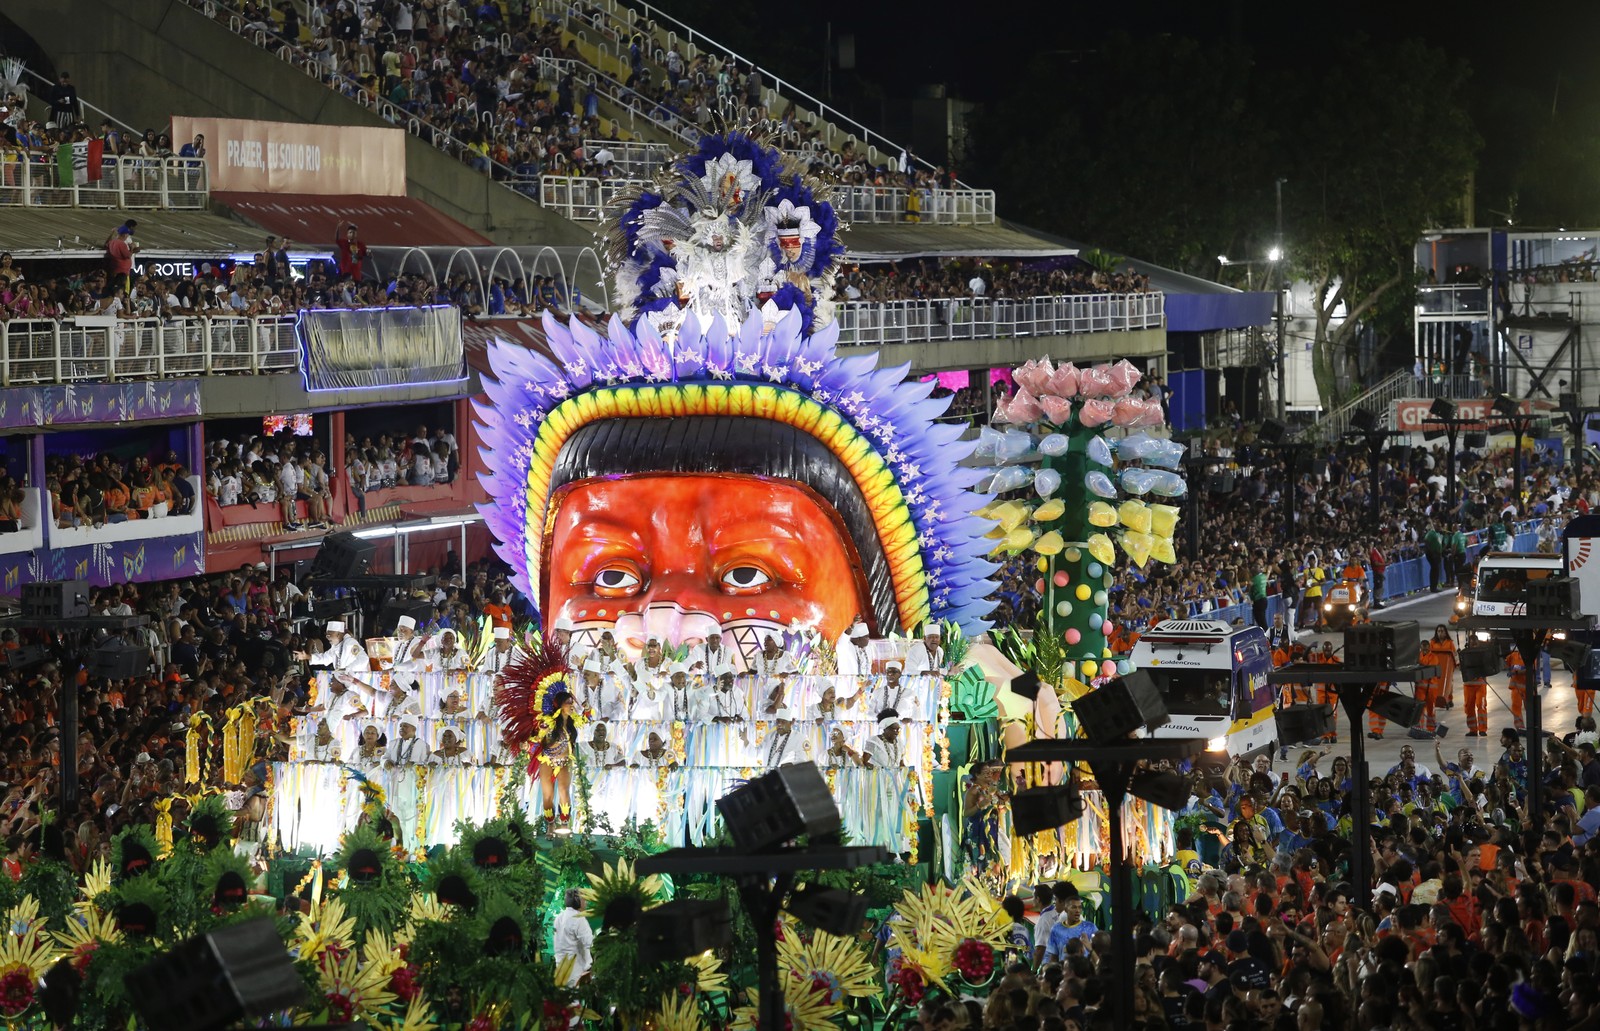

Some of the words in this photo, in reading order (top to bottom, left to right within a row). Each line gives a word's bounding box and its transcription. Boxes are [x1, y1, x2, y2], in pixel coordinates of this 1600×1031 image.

[227, 140, 265, 173] PRAZER,
[267, 142, 278, 169] EU
[280, 143, 297, 170] SOU
[298, 144, 304, 170] O
[306, 145, 320, 171] RIO
[133, 262, 192, 276] MROTE
[1402, 406, 1485, 425] GRDE
